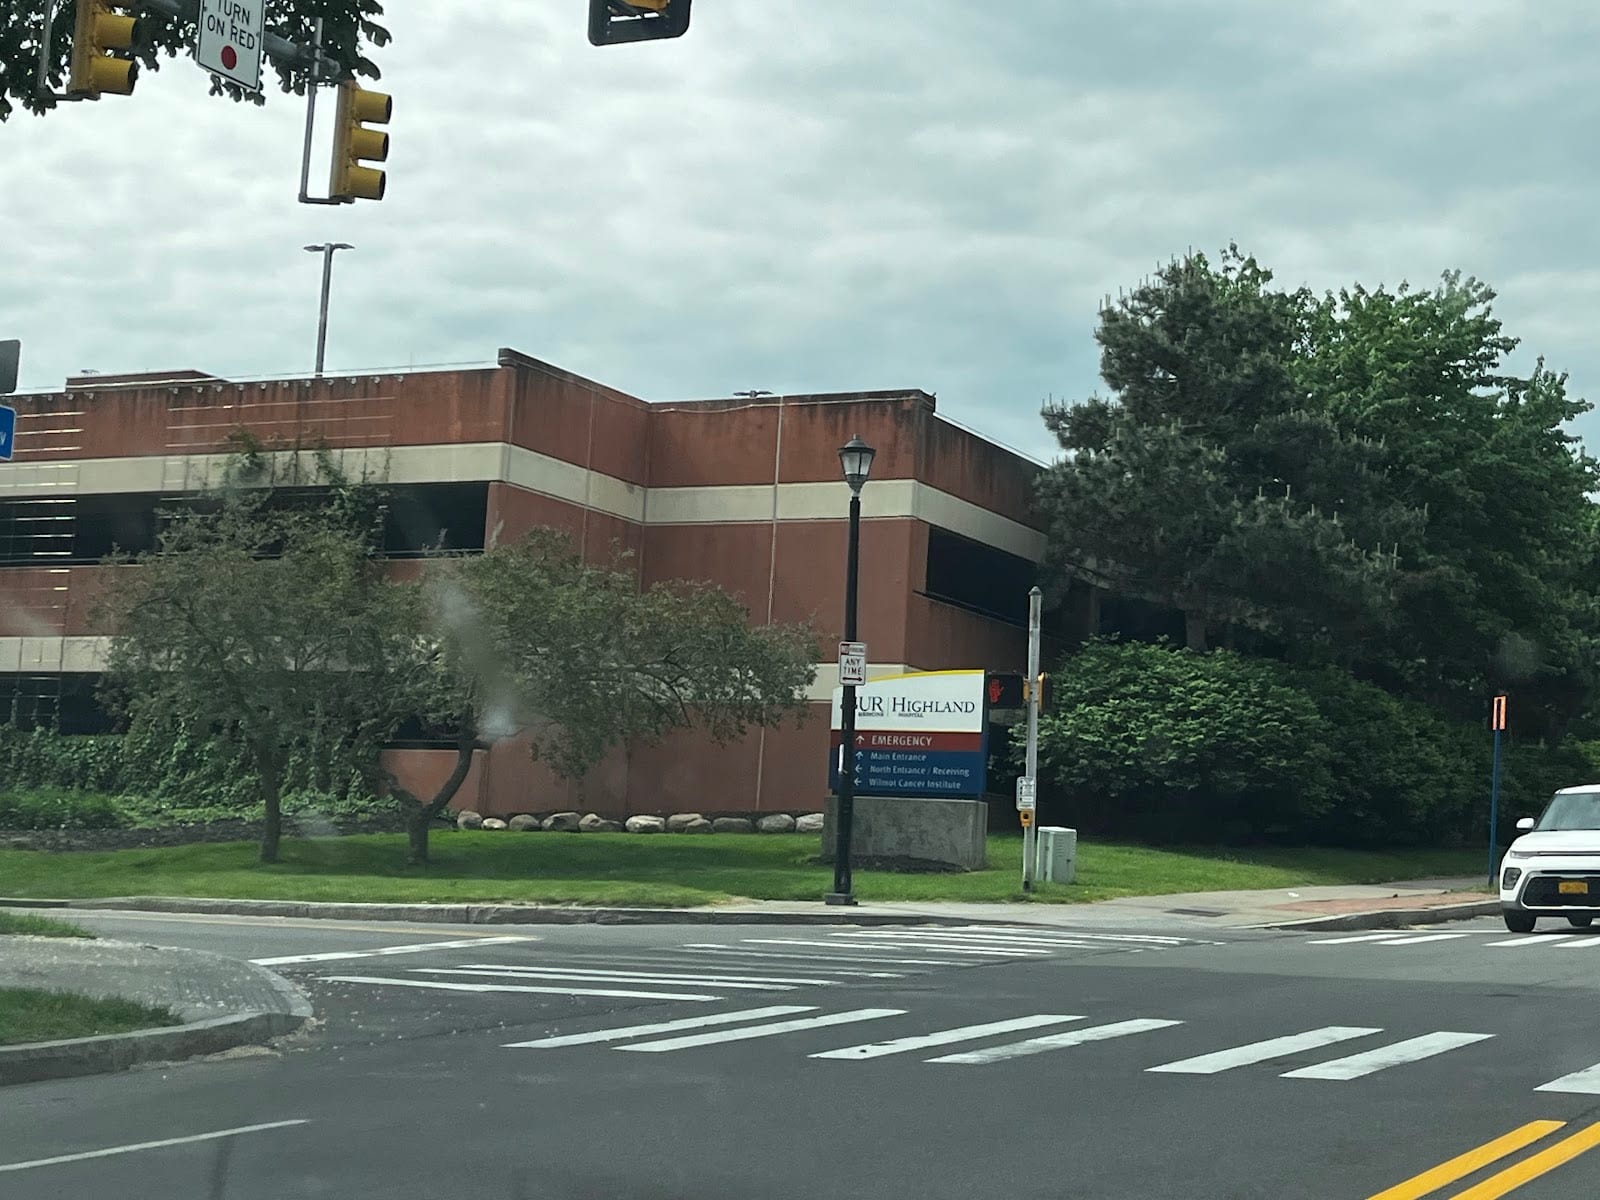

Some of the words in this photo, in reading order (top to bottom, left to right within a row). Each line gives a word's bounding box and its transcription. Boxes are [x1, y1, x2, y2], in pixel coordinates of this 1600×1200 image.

[207, 14, 225, 37] ON
[230, 24, 255, 50] RED
[845, 657, 861, 666] ANY
[843, 666, 862, 676] TIME
[859, 696, 884, 712] UR
[871, 735, 933, 746] EMERGENCY
[870, 752, 890, 760] Main
[892, 752, 927, 761] Entrance
[870, 765, 891, 774] North
[892, 766, 926, 775] Entrance
[932, 766, 970, 777] Receiving
[869, 778, 896, 787] Wilmot
[898, 779, 926, 788] Cancer
[927, 780, 961, 789] Institute
